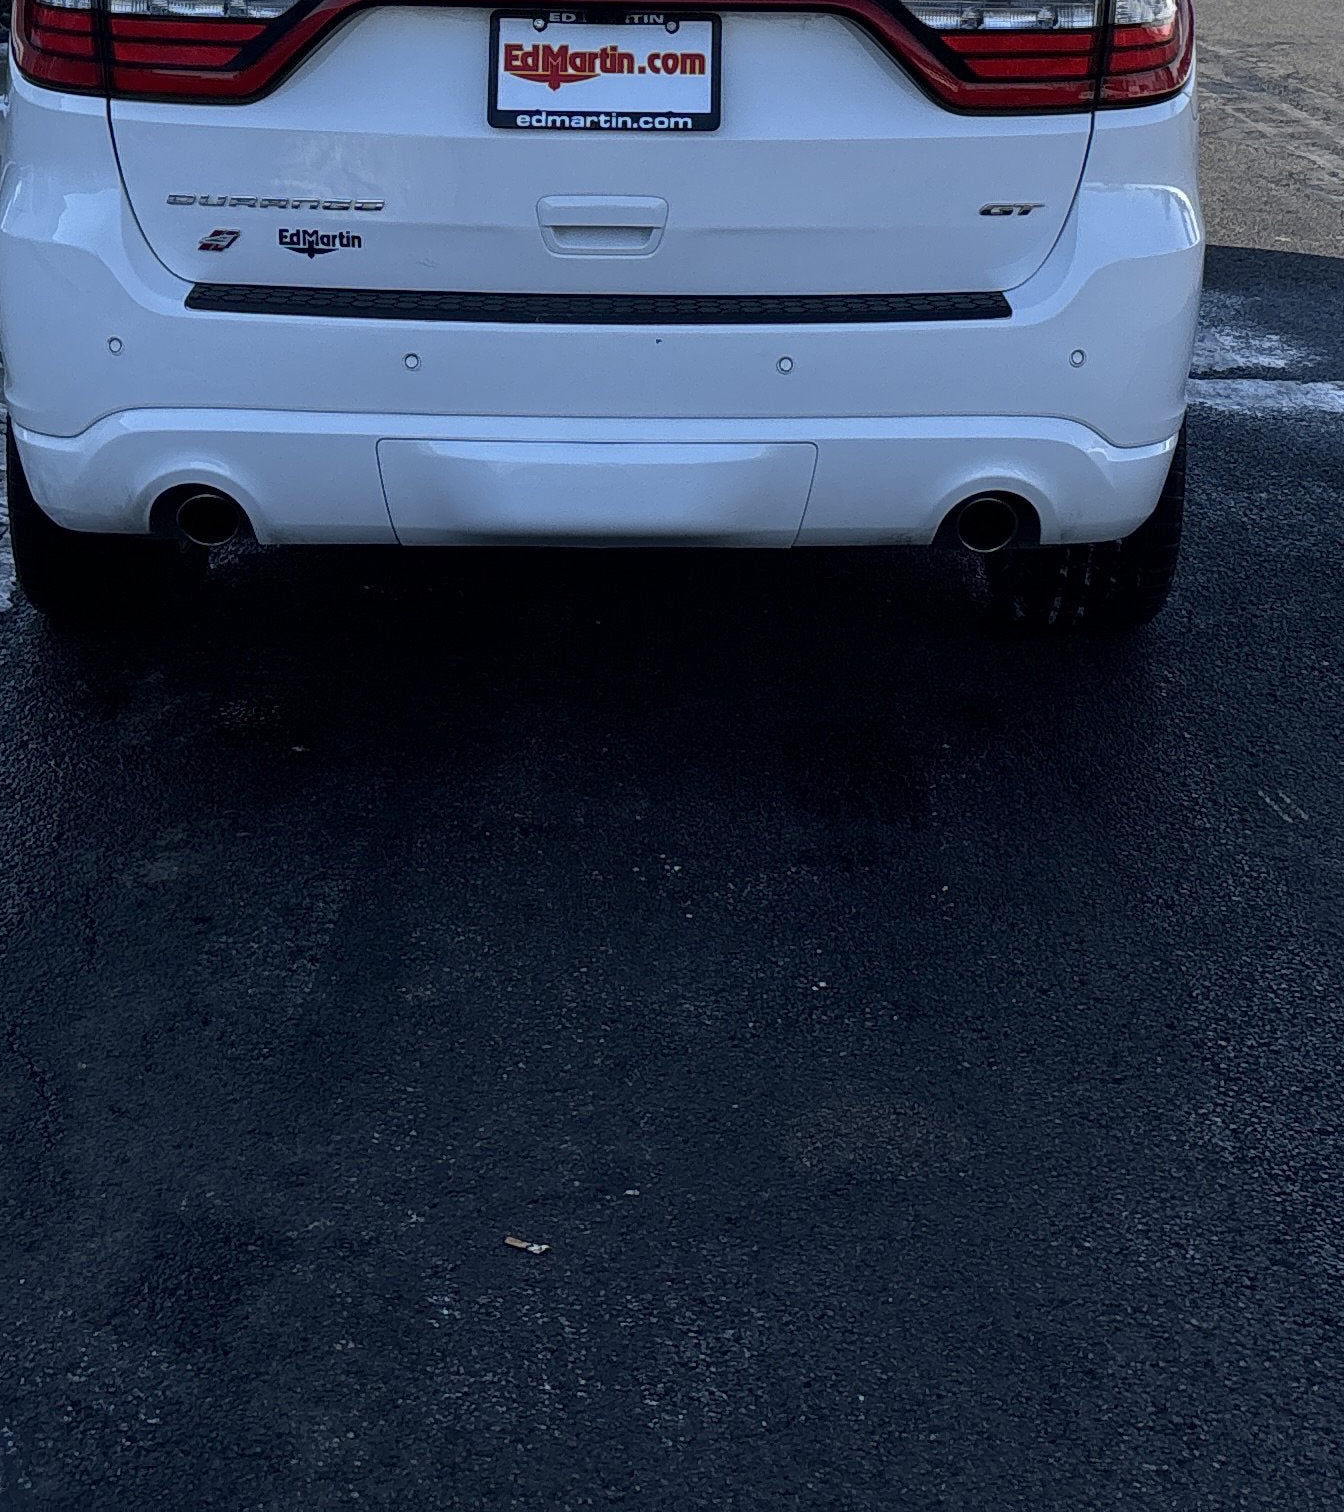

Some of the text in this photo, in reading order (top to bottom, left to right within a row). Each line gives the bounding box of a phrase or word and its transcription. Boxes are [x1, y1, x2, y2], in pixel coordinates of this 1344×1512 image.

[549, 12, 577, 23] ED
[503, 43, 706, 80] EdMartin.com
[516, 111, 693, 130] edmartin.com
[166, 194, 385, 212] DURANGO
[979, 201, 1045, 216] GT
[278, 228, 362, 252] EdMartin
